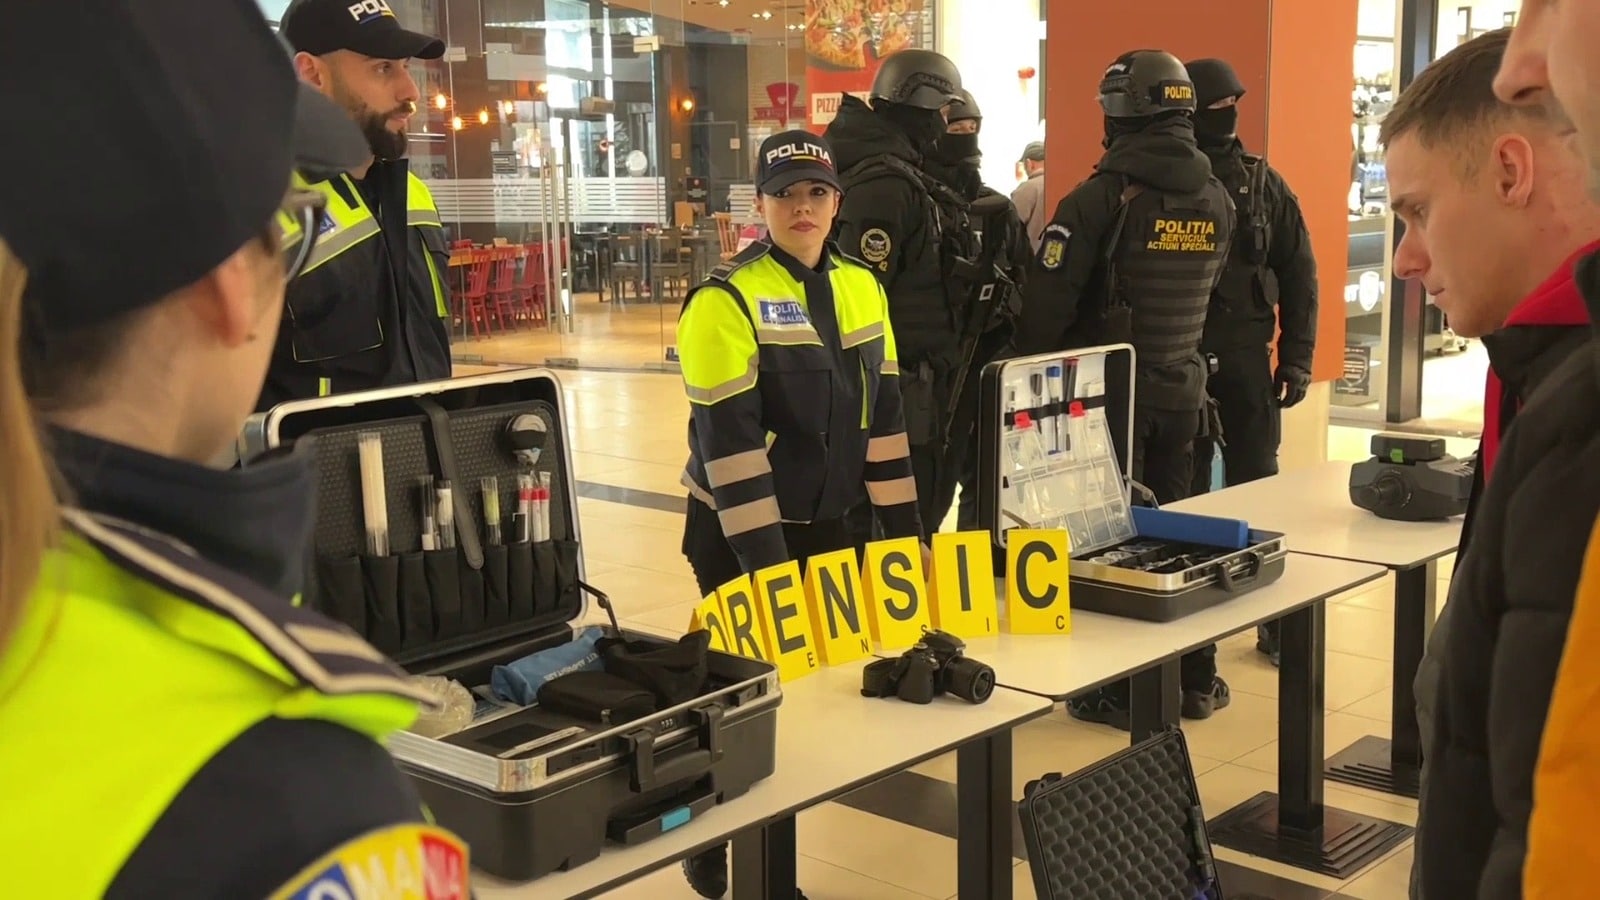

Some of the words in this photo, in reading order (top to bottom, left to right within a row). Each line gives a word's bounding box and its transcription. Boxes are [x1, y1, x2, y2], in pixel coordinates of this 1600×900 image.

[1164, 86, 1192, 99] POLITIA
[766, 142, 832, 165] POLITIA
[1154, 219, 1215, 235] POLITIA
[1160, 232, 1207, 243] SERVICIUL
[1147, 241, 1180, 251] ACTIUNI
[1181, 242, 1216, 251] SPECIALE
[1055, 615, 1065, 630] C
[860, 638, 870, 654] N
[806, 652, 815, 668] E
